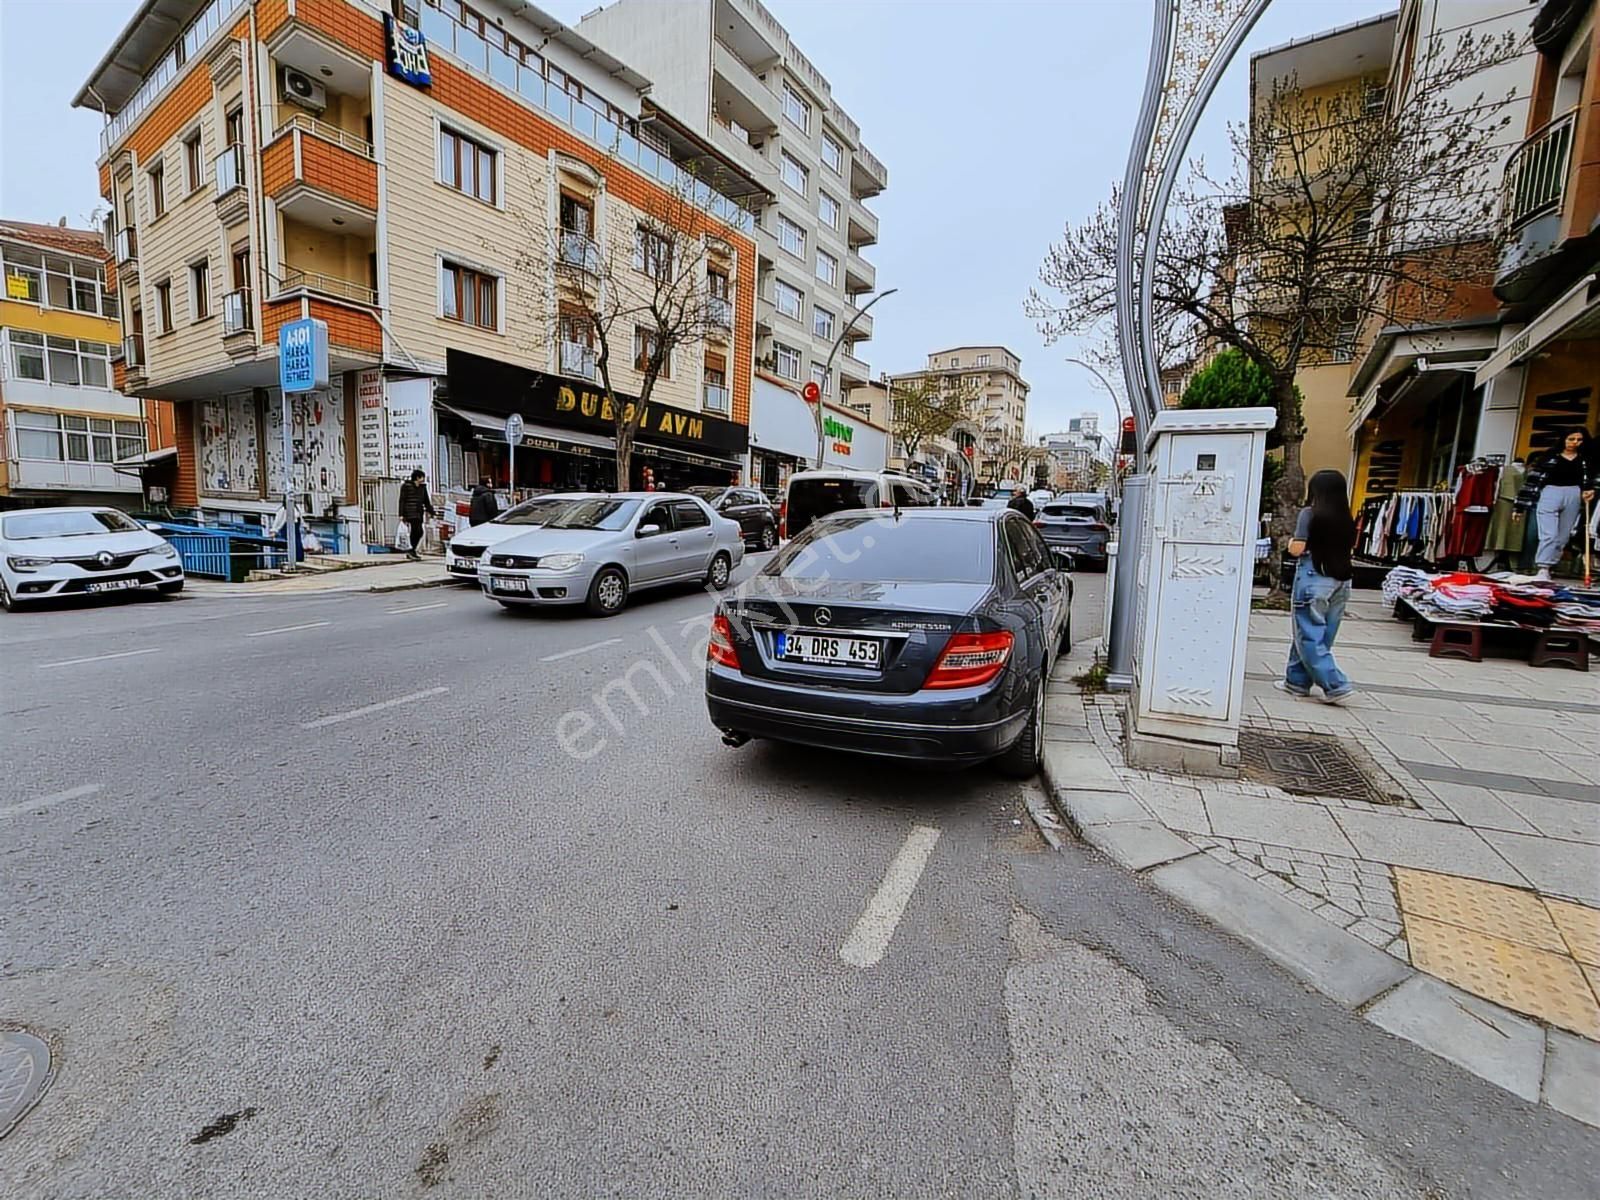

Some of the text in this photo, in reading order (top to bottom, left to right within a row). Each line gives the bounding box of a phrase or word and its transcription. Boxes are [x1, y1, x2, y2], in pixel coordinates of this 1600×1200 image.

[660, 411, 703, 439] AVM
[786, 636, 803, 654] 34
[811, 638, 839, 658] DRS
[849, 641, 878, 662] 453
